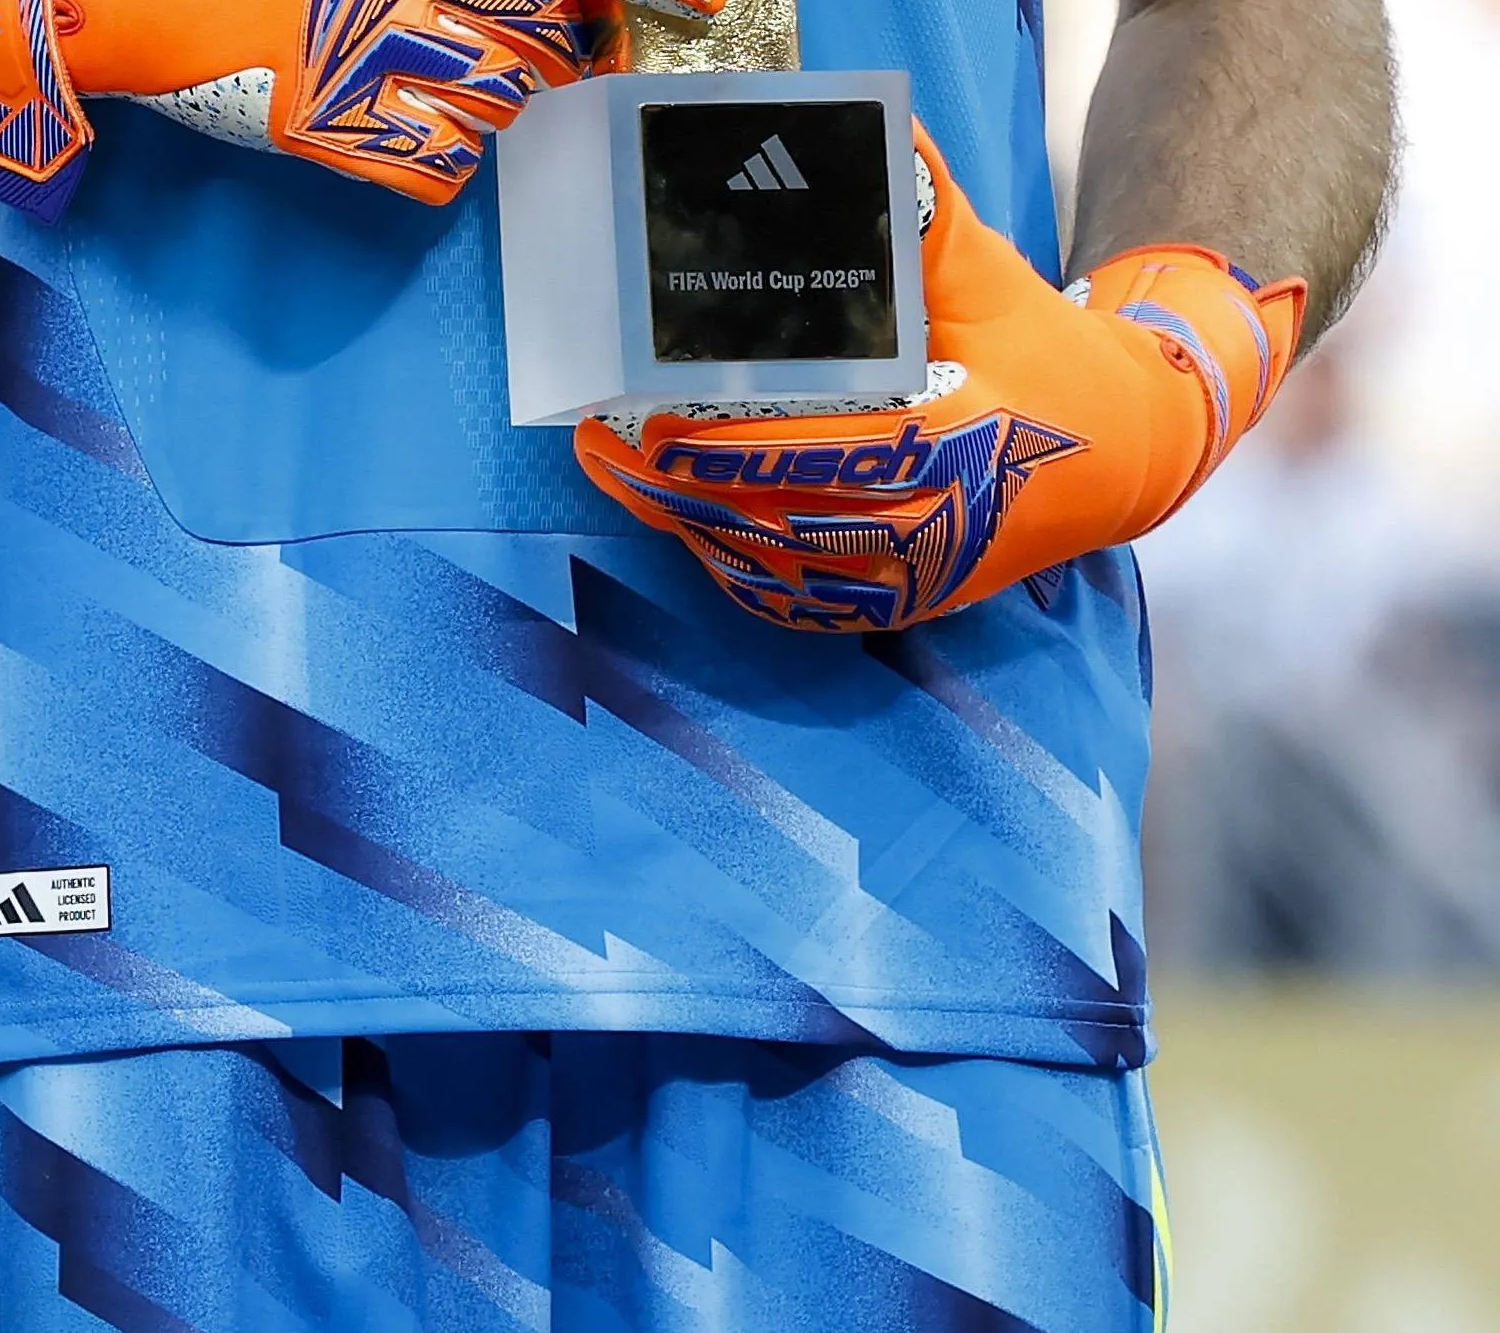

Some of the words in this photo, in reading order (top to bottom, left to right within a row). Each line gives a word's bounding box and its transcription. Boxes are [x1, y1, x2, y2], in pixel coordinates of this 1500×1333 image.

[669, 271, 708, 291] FIFA
[711, 271, 763, 290] World
[769, 270, 804, 293] Cup
[655, 423, 932, 483] reusch
[51, 877, 95, 890] AUTHENTIC
[57, 893, 95, 906] LICENSED
[59, 909, 95, 921] PRODUCT
